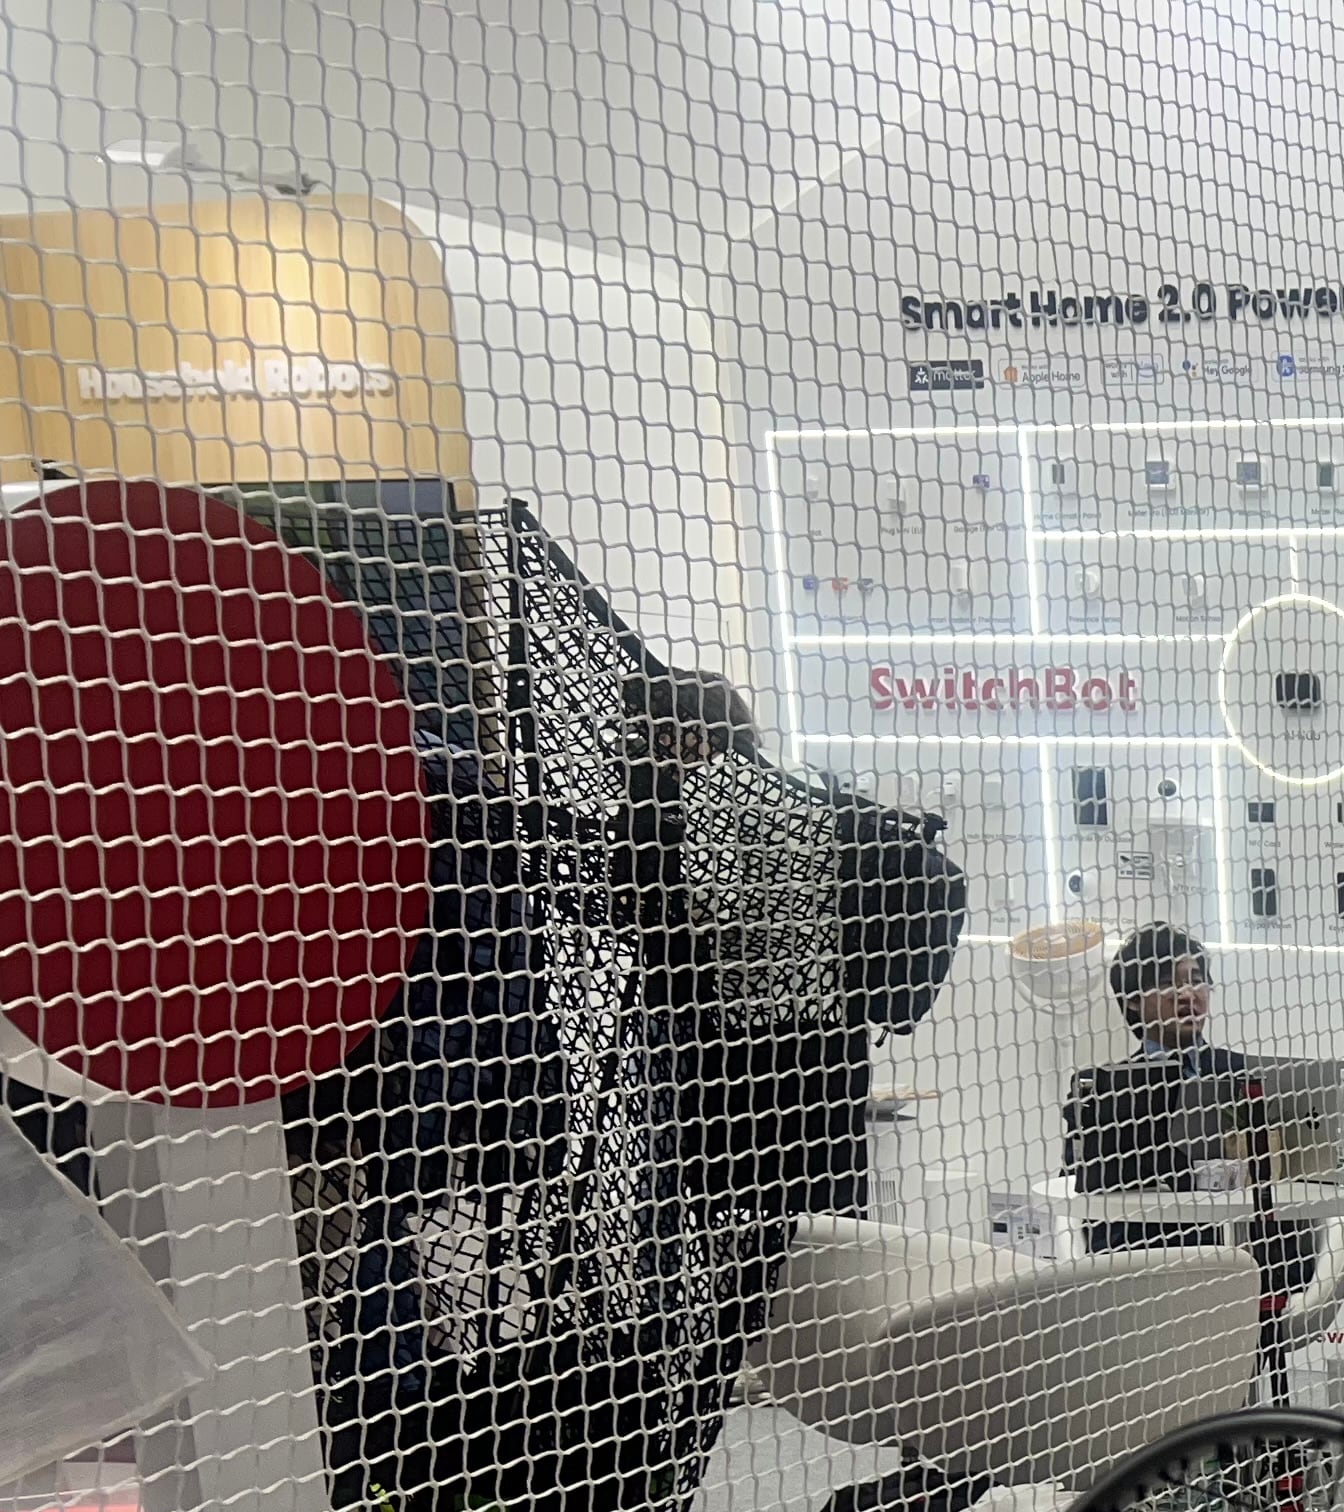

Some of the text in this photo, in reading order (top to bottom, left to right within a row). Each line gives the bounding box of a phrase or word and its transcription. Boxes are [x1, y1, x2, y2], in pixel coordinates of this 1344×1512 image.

[901, 292, 1023, 331] Smart
[1029, 289, 1148, 327] Home
[1157, 283, 1217, 323] 2.0
[264, 358, 395, 397] Robots
[1022, 370, 1081, 385] Apple Home
[868, 665, 1138, 713] SwitchBot
